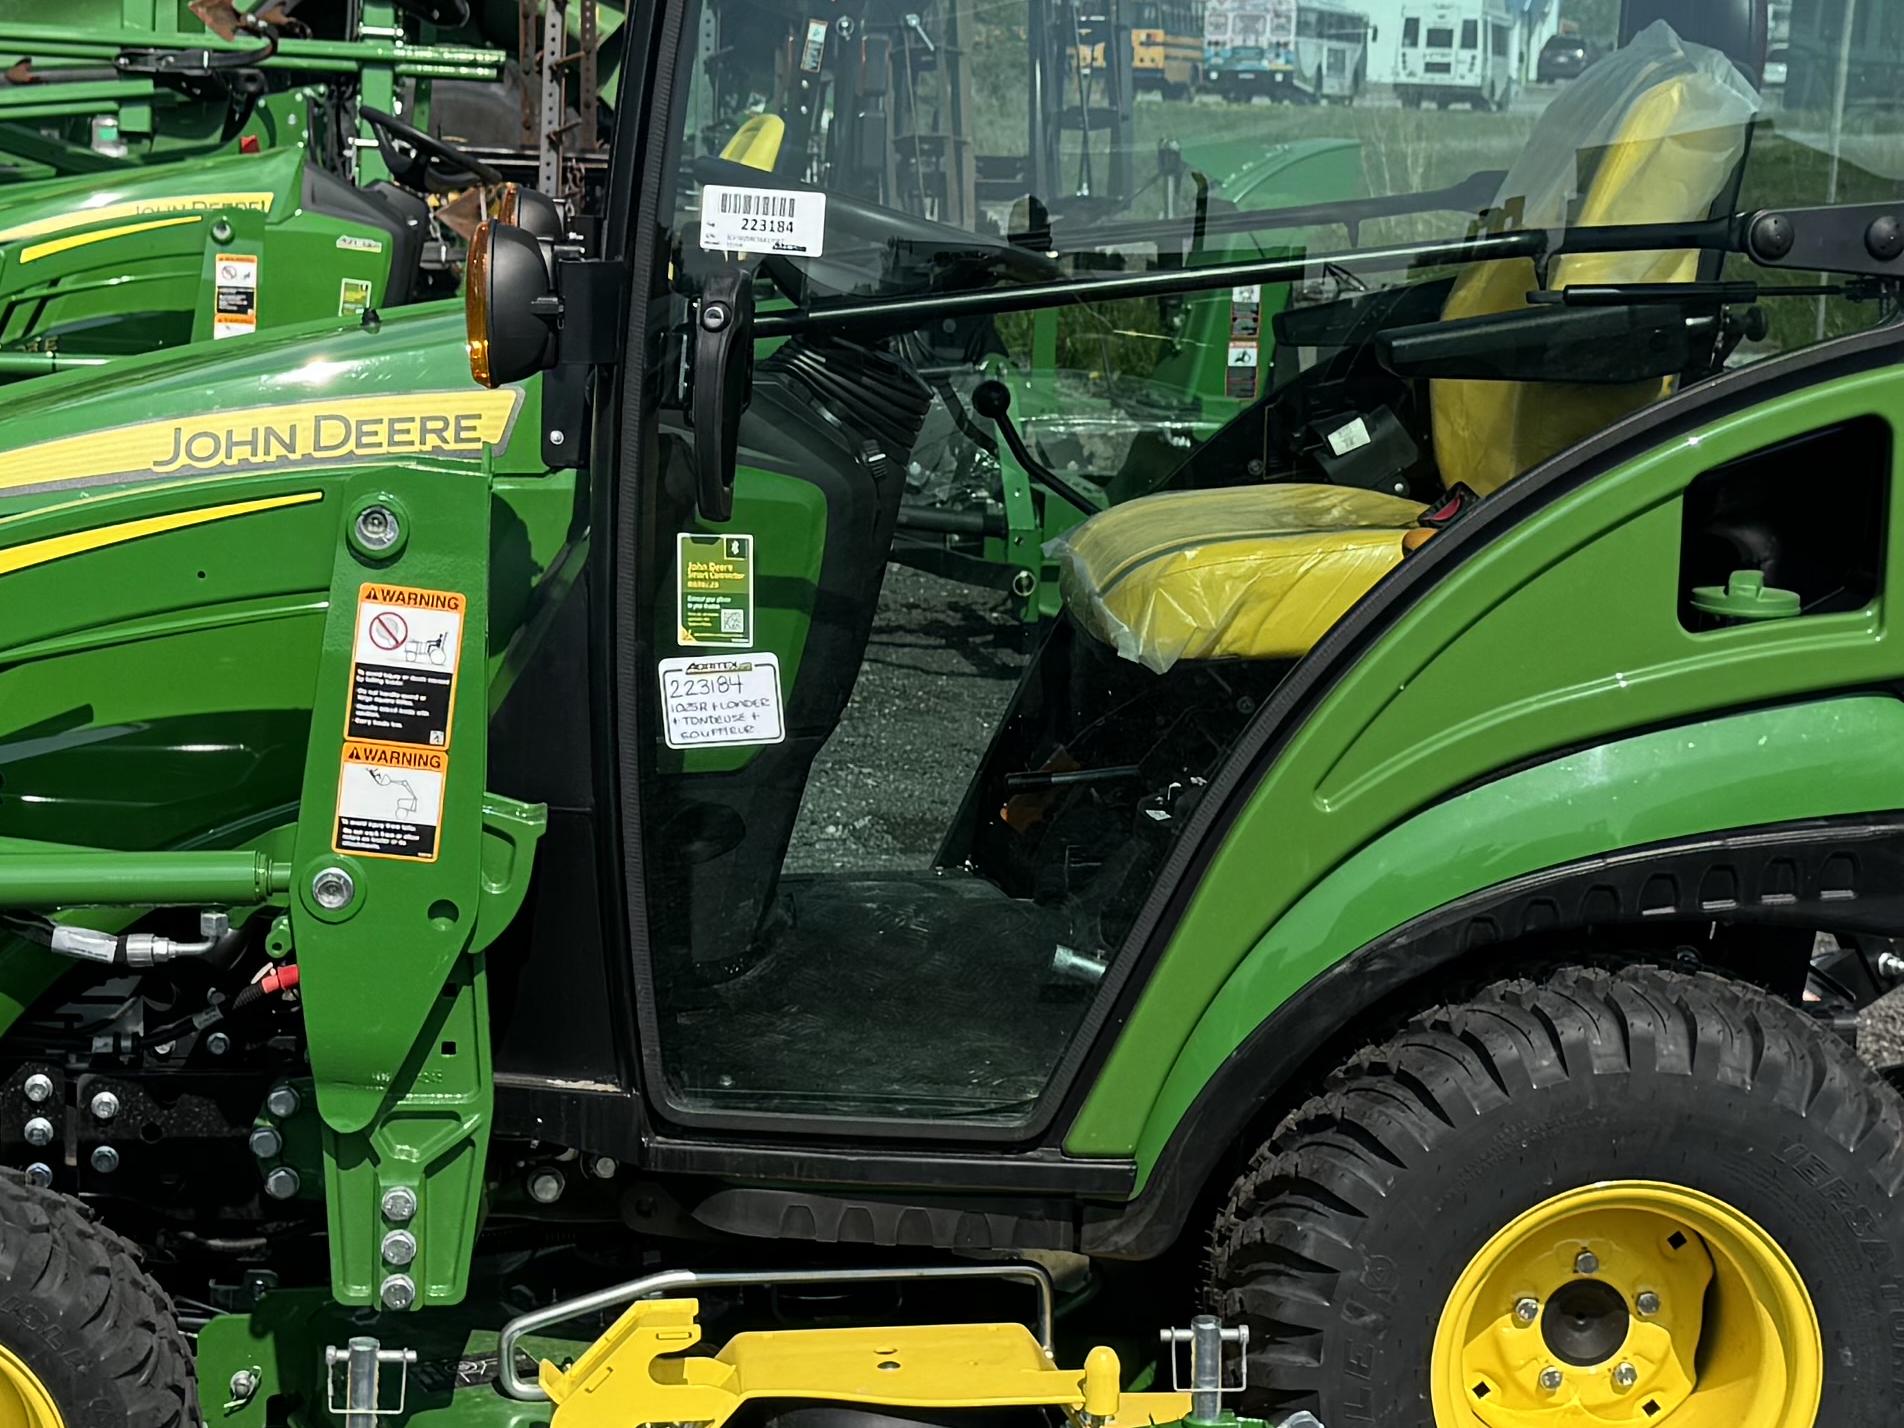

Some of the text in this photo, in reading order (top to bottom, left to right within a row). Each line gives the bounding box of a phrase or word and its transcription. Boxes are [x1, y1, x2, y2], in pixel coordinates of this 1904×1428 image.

[741, 218, 793, 233] 223184
[152, 413, 483, 467] JOHN DEERE
[381, 588, 459, 610] WARNING
[669, 674, 744, 699] 223184
[363, 747, 441, 769] WARNING
